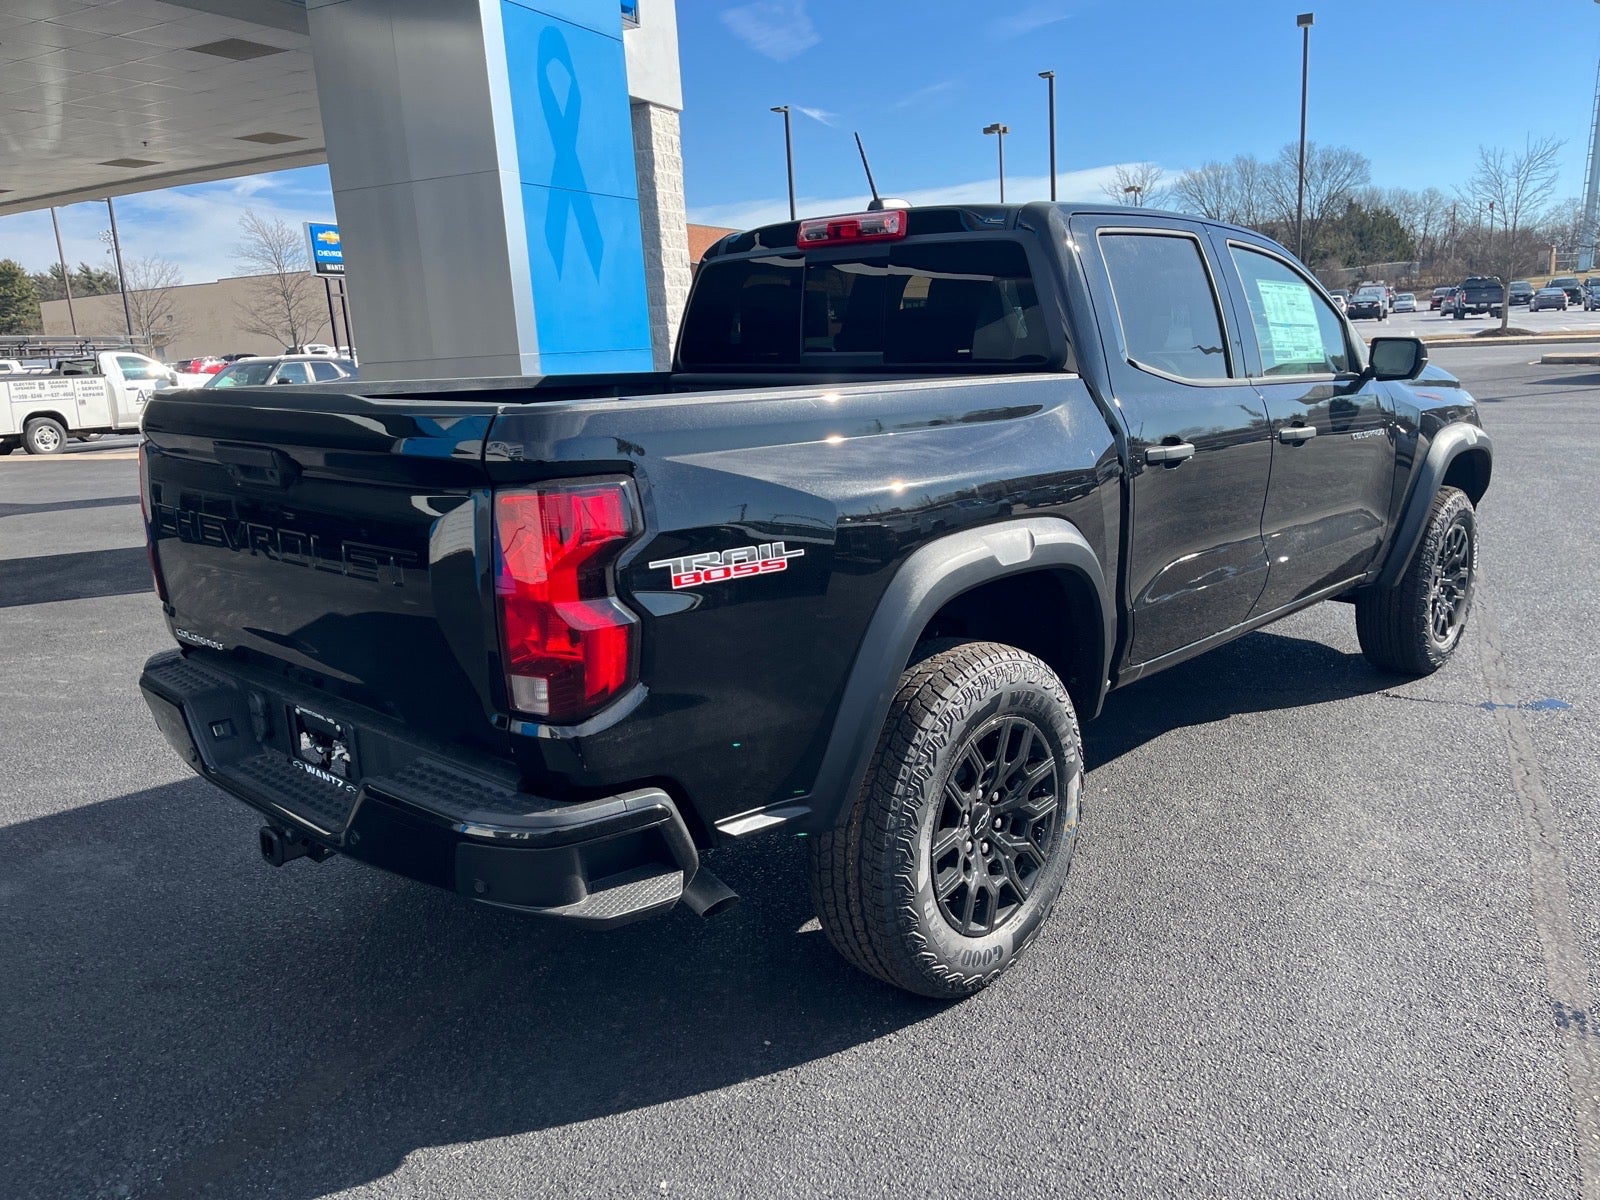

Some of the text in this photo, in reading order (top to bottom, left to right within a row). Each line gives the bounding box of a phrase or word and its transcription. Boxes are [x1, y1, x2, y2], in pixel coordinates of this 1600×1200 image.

[155, 502, 418, 587] CHEVROLET
[648, 541, 805, 575] TRAIL
[671, 557, 788, 590] BOSS
[1009, 690, 1076, 764] WRANGLER
